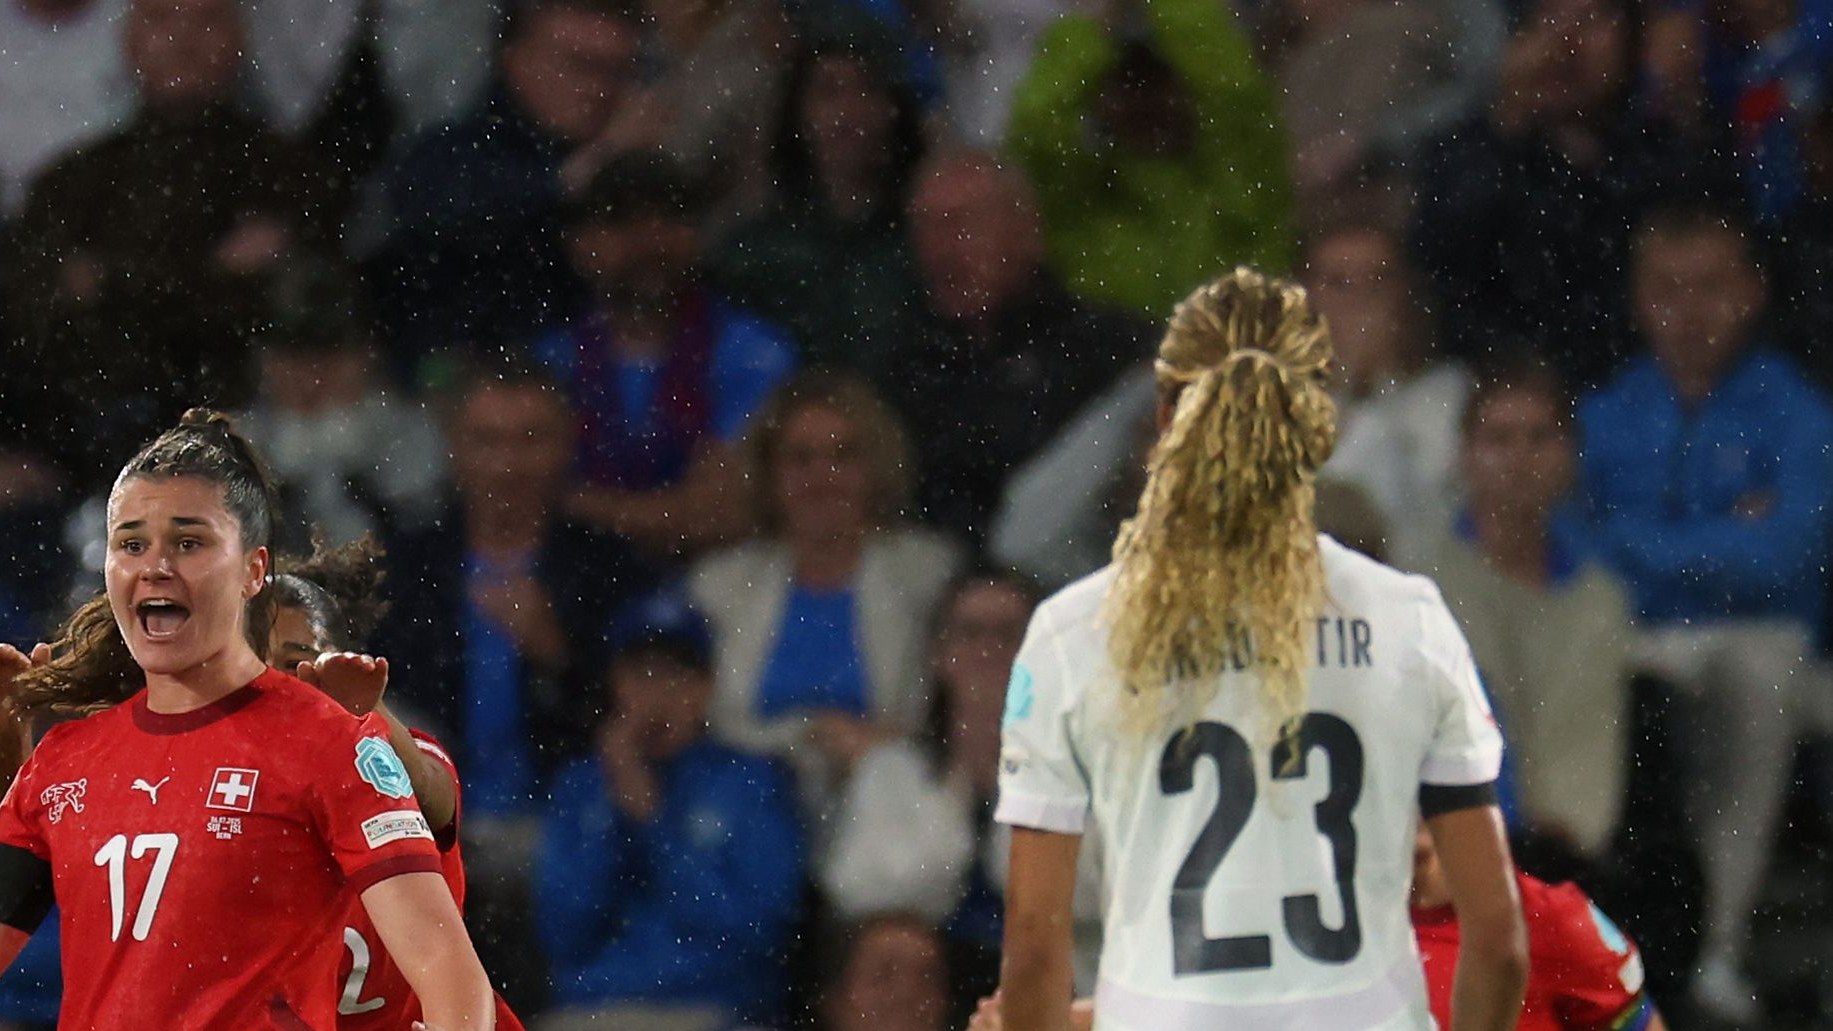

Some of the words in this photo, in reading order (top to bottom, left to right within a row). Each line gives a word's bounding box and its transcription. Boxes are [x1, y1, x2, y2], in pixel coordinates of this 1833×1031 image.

[206, 823, 221, 832] SUI
[229, 824, 243, 834] ISL
[1160, 712, 1366, 979] 23
[94, 833, 179, 942] 17
